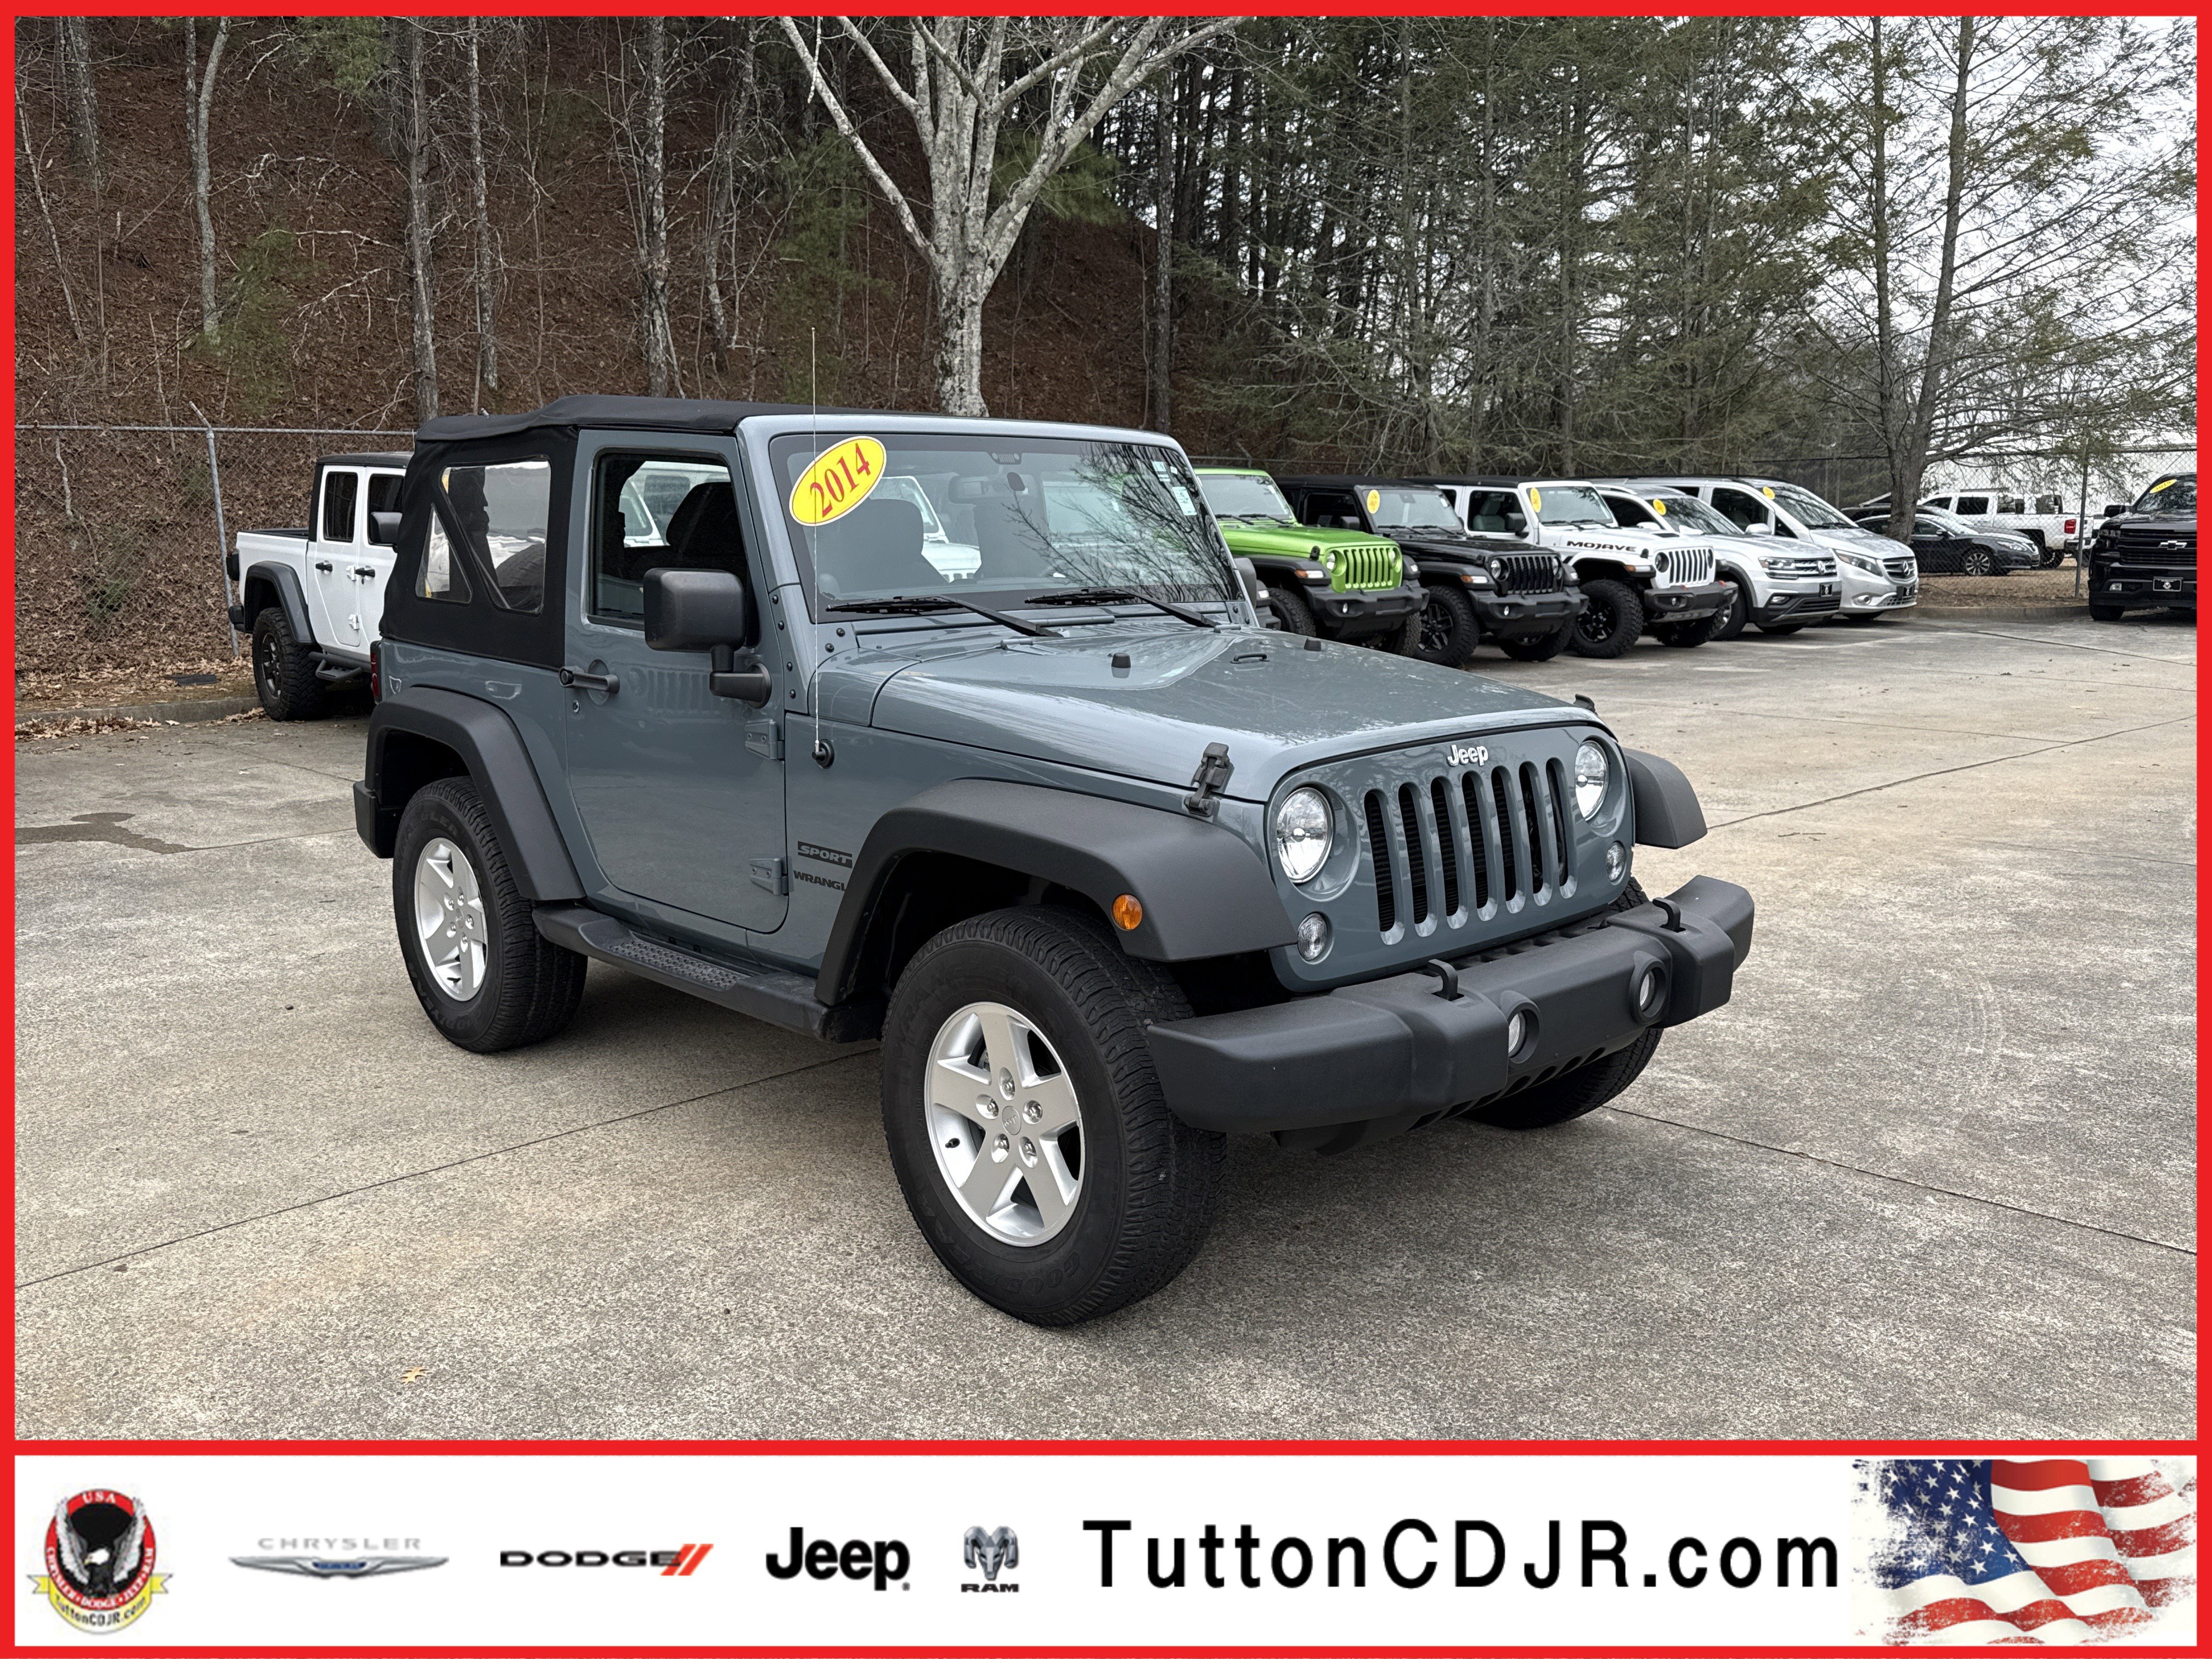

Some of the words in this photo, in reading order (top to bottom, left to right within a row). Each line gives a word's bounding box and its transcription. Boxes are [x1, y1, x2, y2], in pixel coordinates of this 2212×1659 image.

[810, 443, 871, 518] 2014
[1566, 540, 1636, 552] MOJAVE
[1447, 744, 1488, 766] Jeep
[799, 845, 850, 864] SPORT
[793, 870, 847, 891] WRANGL
